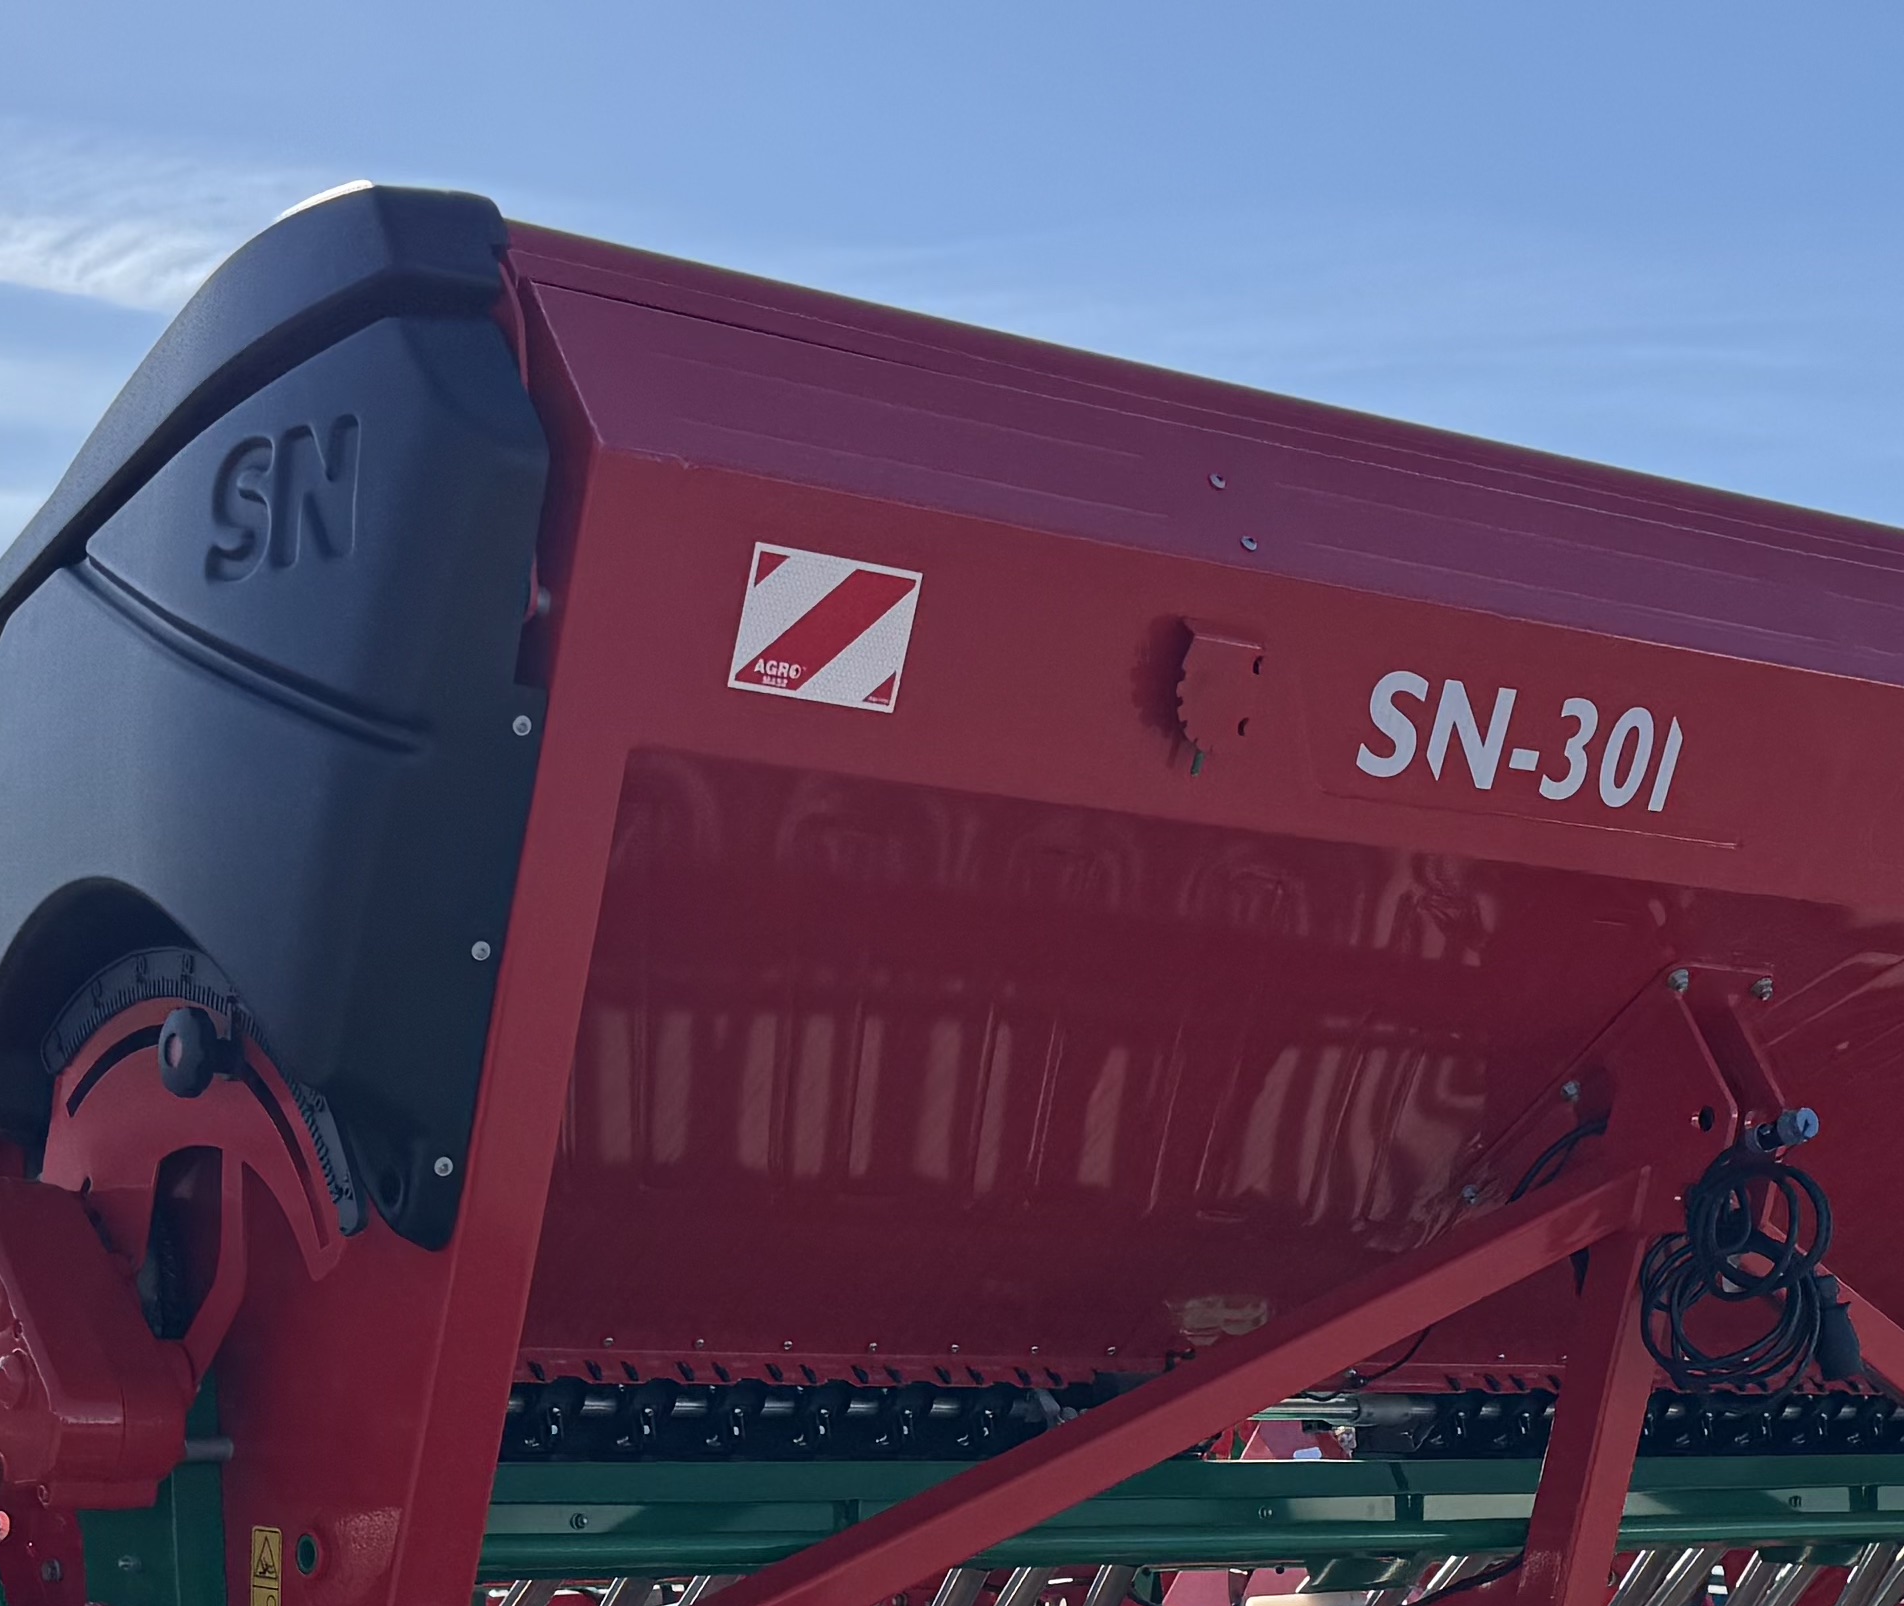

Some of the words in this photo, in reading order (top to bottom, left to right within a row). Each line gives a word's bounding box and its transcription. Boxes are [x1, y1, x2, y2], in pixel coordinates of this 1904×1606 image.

[205, 413, 361, 584] SN
[754, 658, 802, 679] AGRO
[1355, 670, 1684, 813] SN-301
